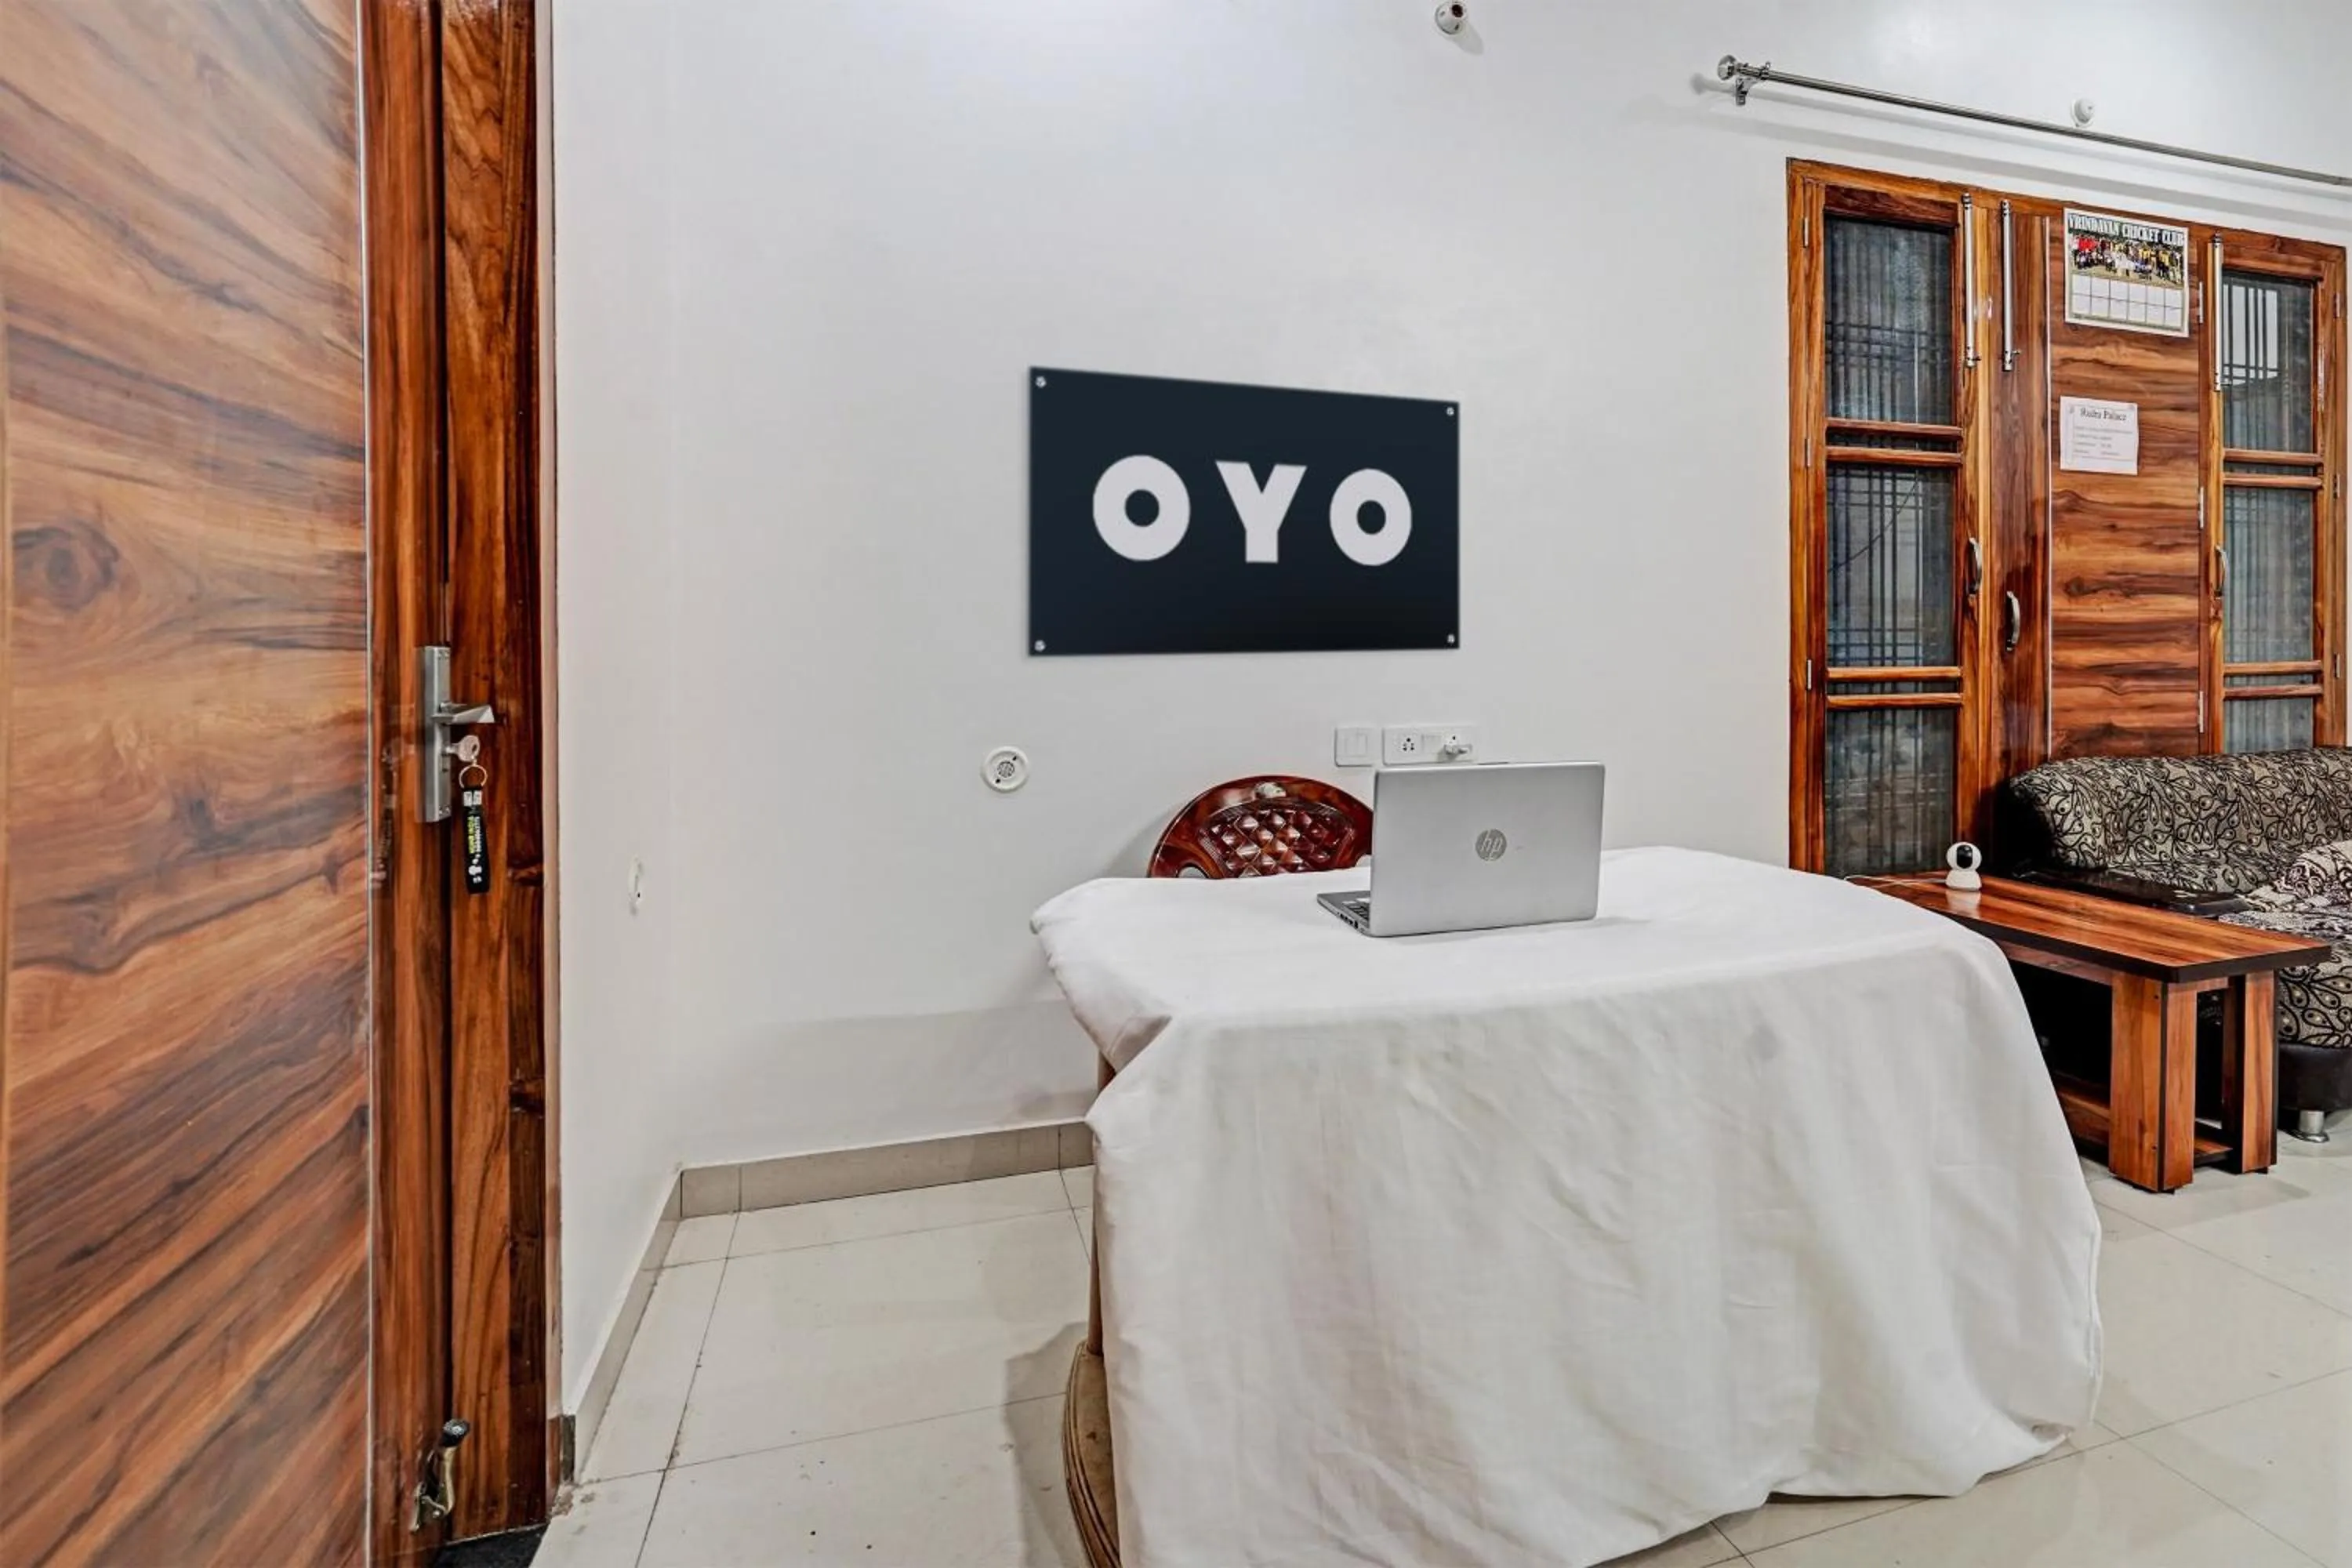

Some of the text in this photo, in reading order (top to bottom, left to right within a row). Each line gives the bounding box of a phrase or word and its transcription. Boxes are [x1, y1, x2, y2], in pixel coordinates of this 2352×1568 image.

[2122, 223, 2160, 242] CRICKET
[2161, 229, 2184, 247] CLUB
[1093, 455, 1412, 566] OYO
[1478, 829, 1504, 862] hp
